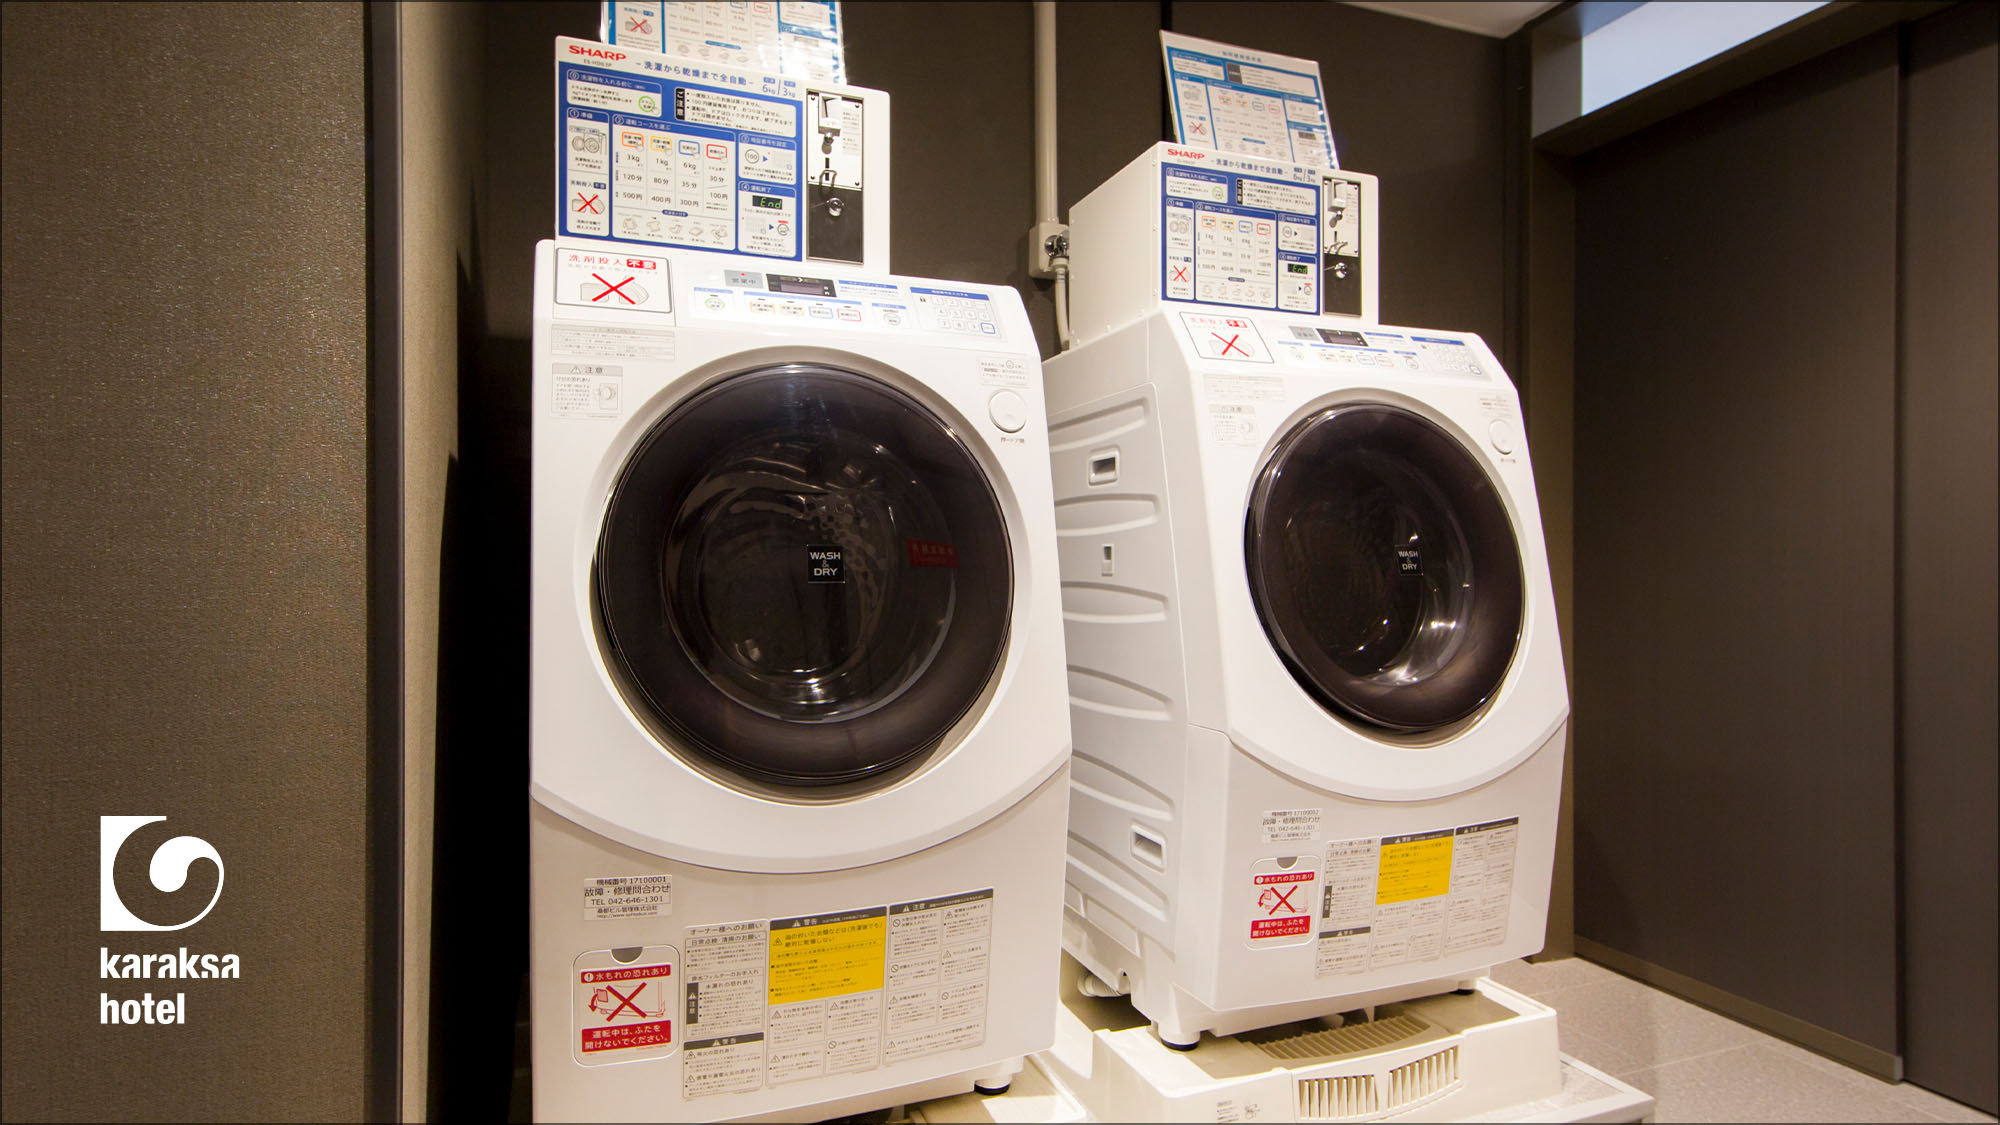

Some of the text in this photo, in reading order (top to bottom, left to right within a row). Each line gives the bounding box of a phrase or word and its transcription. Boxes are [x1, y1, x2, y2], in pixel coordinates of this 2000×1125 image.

[568, 45, 627, 61] SHARP
[1167, 148, 1205, 160] SHARP
[760, 197, 782, 209] End
[810, 552, 841, 560] WASH
[1398, 550, 1418, 558] WASH
[813, 567, 838, 576] DRY
[630, 876, 666, 884] 17100001
[591, 896, 663, 906] TEL 042-646-1301
[595, 967, 668, 981] 水もれの恐れあり
[592, 1024, 661, 1039] 運転中は、ふたを
[584, 1035, 668, 1050] 開けないでください。
